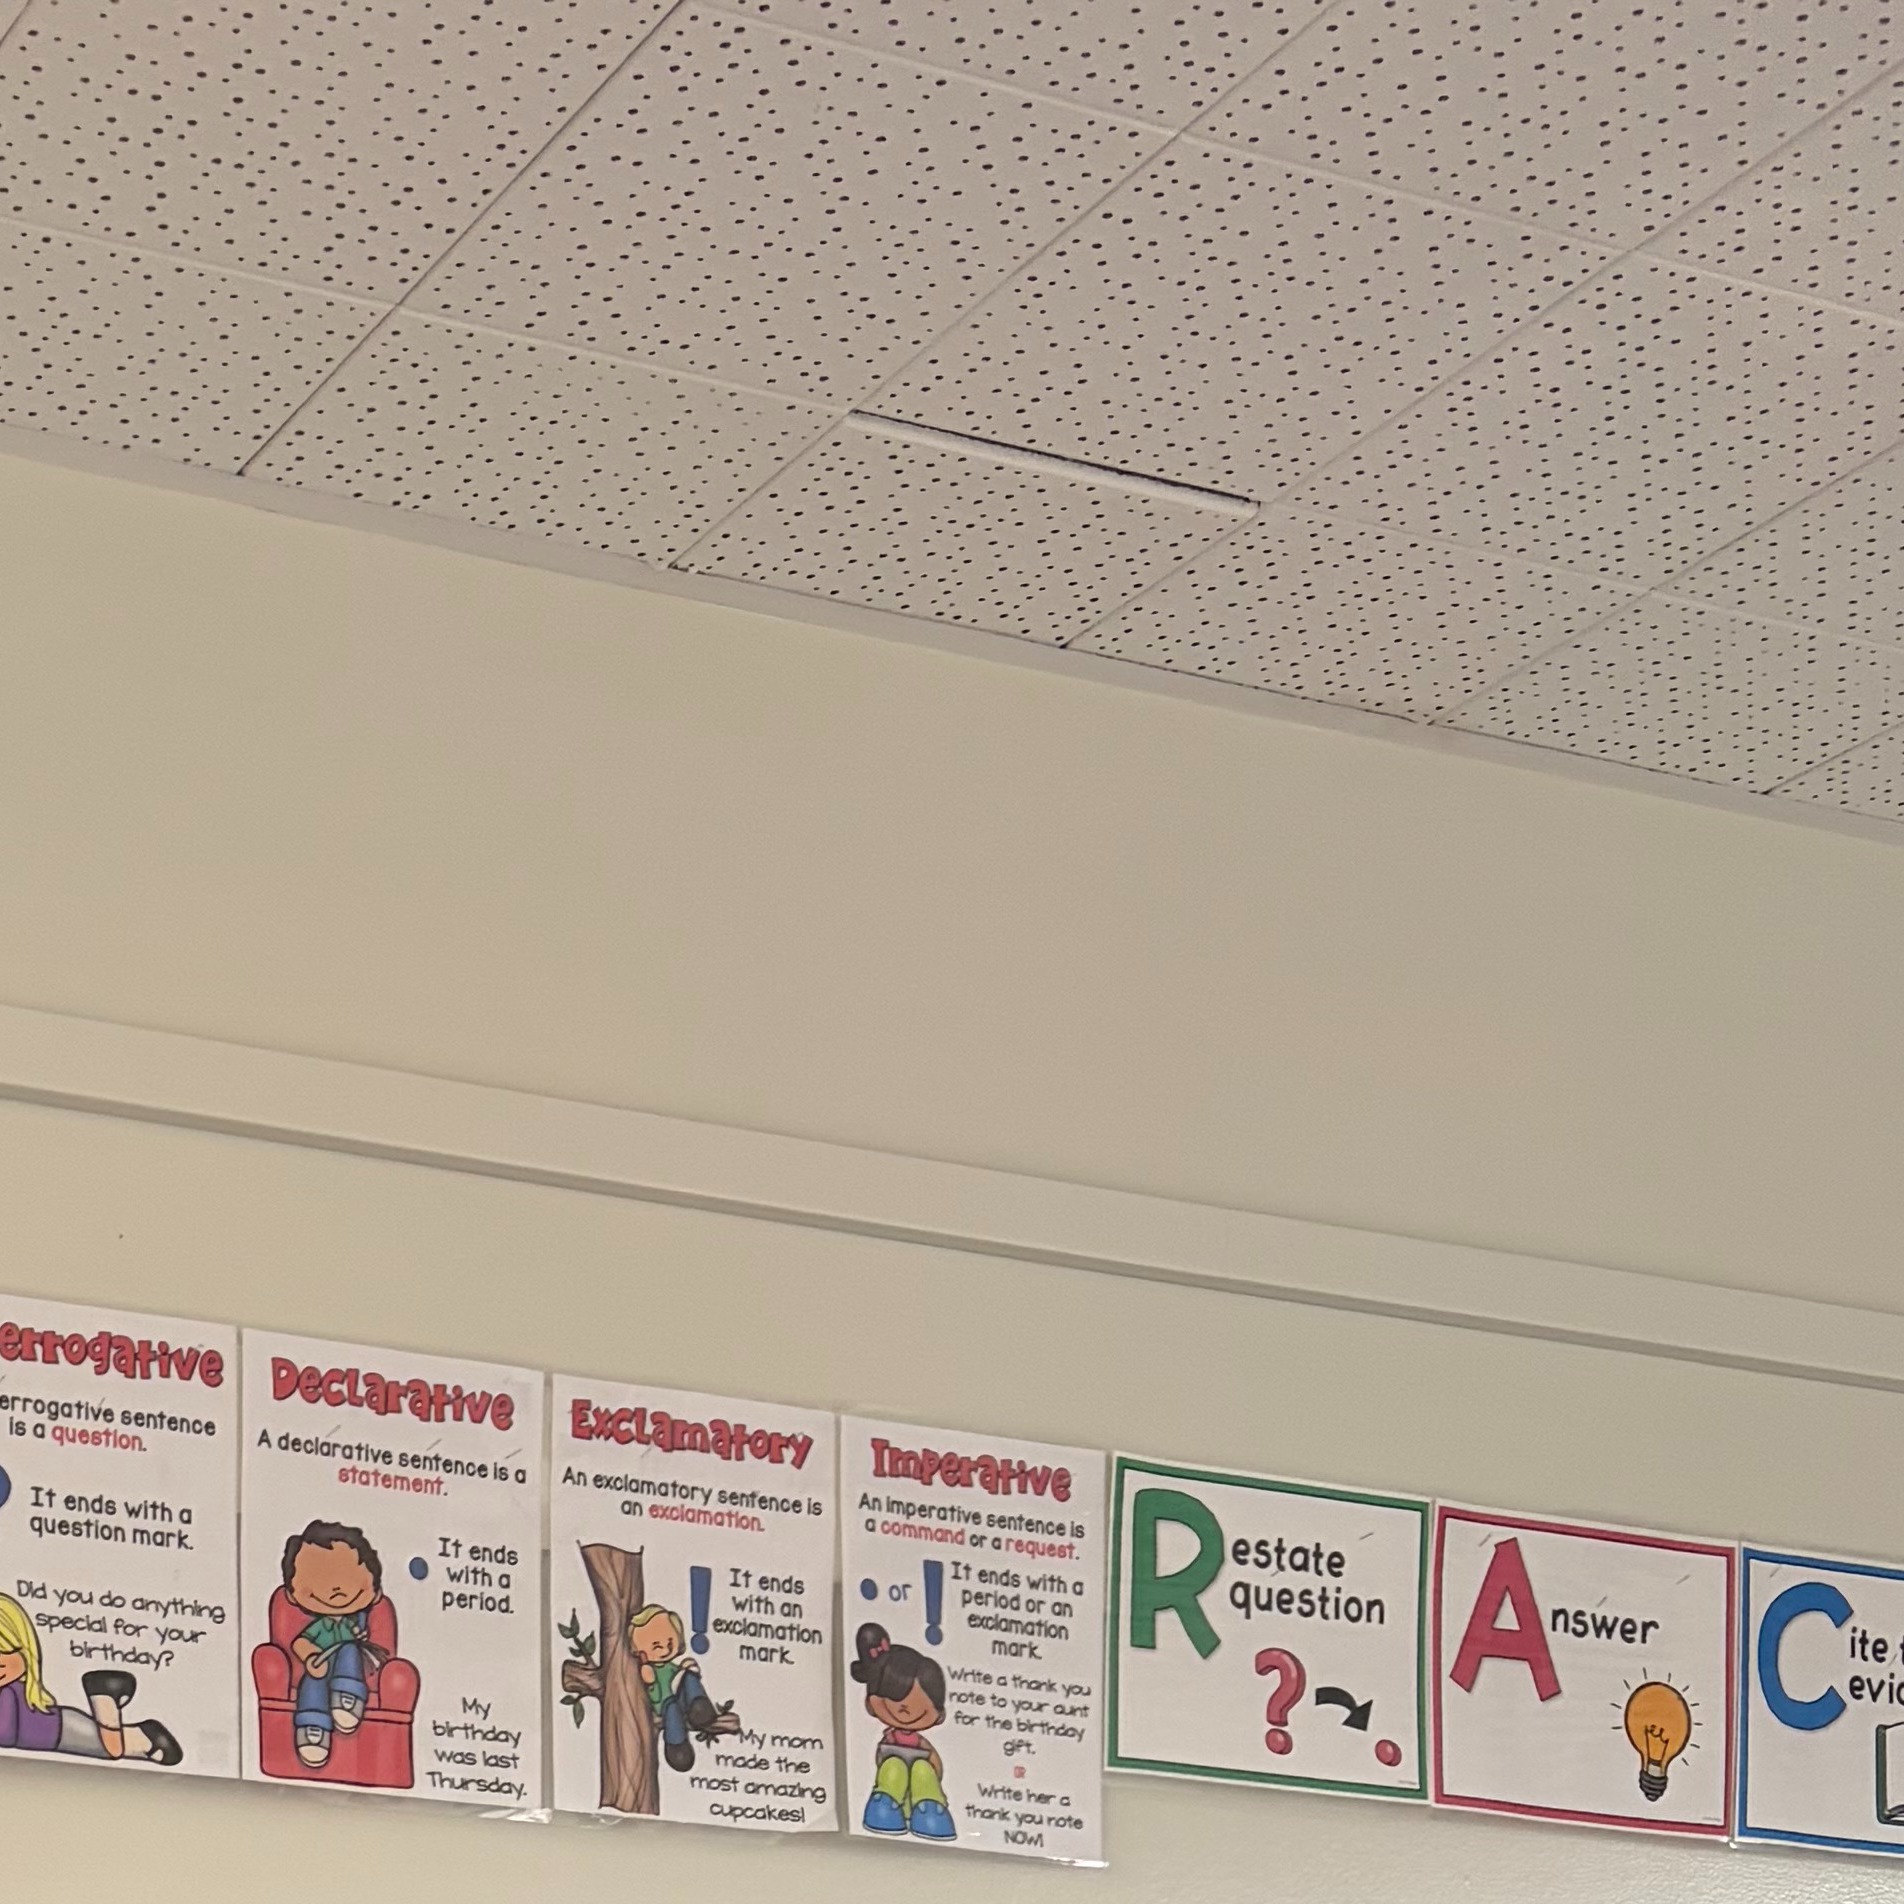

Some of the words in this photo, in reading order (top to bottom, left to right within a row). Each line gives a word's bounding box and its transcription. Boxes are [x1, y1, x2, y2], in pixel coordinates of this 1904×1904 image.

[9, 1416, 27, 1437] is
[32, 1423, 45, 1439] a
[51, 1425, 147, 1452] question.
[121, 1408, 216, 1436] sentence
[257, 1429, 272, 1449] A
[277, 1432, 393, 1465] declarative
[398, 1452, 488, 1478] sentence
[493, 1462, 509, 1481] is
[514, 1469, 526, 1484] a
[337, 1465, 449, 1497] statement.
[562, 1466, 587, 1487] An
[592, 1474, 713, 1506] exclamatory
[717, 1490, 802, 1514] sentence
[807, 1497, 823, 1516] is
[30, 1486, 57, 1508] It
[63, 1494, 117, 1516] ends
[124, 1500, 173, 1523] with
[179, 1508, 192, 1525] a
[620, 1500, 643, 1517] an
[648, 1504, 765, 1532] exclamation.
[858, 1492, 882, 1512] An
[886, 1496, 982, 1526] imperative
[986, 1514, 1066, 1537] sentence
[1070, 1521, 1085, 1539] is
[30, 1516, 126, 1544] question
[132, 1528, 194, 1550] mark.
[865, 1518, 876, 1532] a
[880, 1520, 966, 1546] command
[969, 1534, 988, 1548] or
[991, 1537, 1002, 1550] a
[1005, 1538, 1080, 1560] request.
[438, 1537, 463, 1559] It
[468, 1545, 518, 1566] ends
[446, 1565, 492, 1587] with
[498, 1573, 511, 1589] a
[729, 1568, 753, 1588] It
[758, 1575, 805, 1595] ends
[951, 1561, 972, 1581] It
[977, 1569, 1021, 1588] ends
[1026, 1574, 1067, 1594] with
[1072, 1581, 1084, 1596] a
[16, 1579, 48, 1600] Did
[53, 1589, 94, 1607] you
[99, 1590, 126, 1608] do
[131, 1597, 226, 1624] anything
[442, 1591, 514, 1614] period.
[731, 1594, 775, 1615] with
[780, 1602, 803, 1619] an
[888, 1583, 912, 1602] or
[961, 1589, 1021, 1611] period
[1025, 1598, 1046, 1614] or
[1051, 1601, 1073, 1618] an
[1229, 1580, 1385, 1625] question
[35, 1613, 107, 1633] special
[113, 1618, 149, 1638] for
[155, 1626, 207, 1646] your
[712, 1617, 823, 1645] exclamation
[967, 1613, 1069, 1641] exclamation
[69, 1639, 175, 1671] birthday?
[739, 1644, 795, 1665] mark.
[992, 1640, 1043, 1660] mark.
[947, 1666, 993, 1685] Write
[996, 1676, 1008, 1686] a
[1011, 1674, 1057, 1693] thank
[1061, 1684, 1092, 1699] you
[462, 1697, 491, 1721] My
[949, 1691, 986, 1706] note
[990, 1693, 1008, 1708] to
[1011, 1699, 1050, 1715] your
[1053, 1704, 1090, 1718] aunt
[432, 1720, 522, 1749] birthday
[739, 1728, 767, 1749] My
[771, 1735, 824, 1750] mom
[954, 1710, 981, 1726] for
[984, 1715, 1013, 1731] the
[1016, 1718, 1086, 1743] birthday
[434, 1749, 477, 1766] was
[482, 1750, 520, 1769] last
[1003, 1739, 1036, 1757] gift.
[715, 1754, 770, 1771] made
[775, 1756, 811, 1774] the
[425, 1771, 527, 1801] Thursday.
[690, 1776, 740, 1792] most
[744, 1782, 827, 1804] amazing
[709, 1803, 805, 1823] cupcakes!
